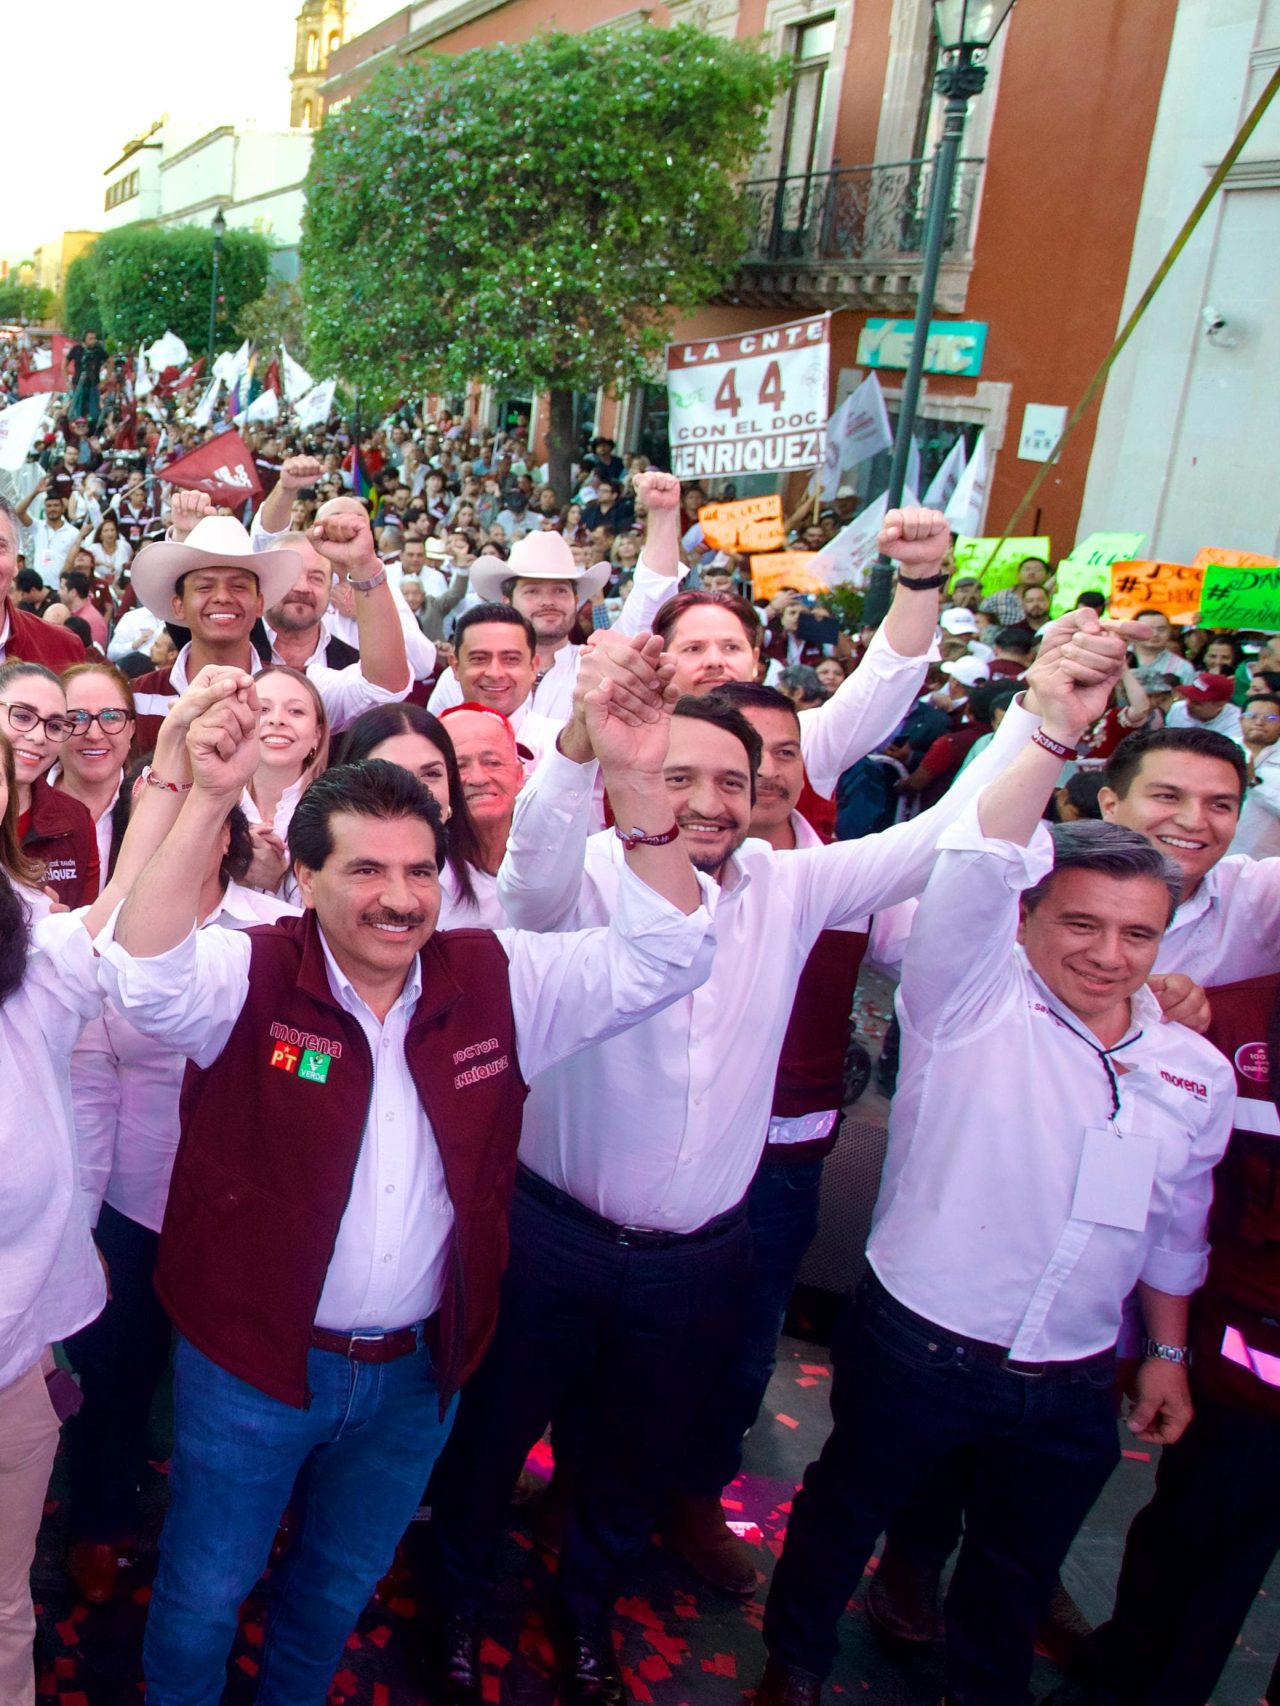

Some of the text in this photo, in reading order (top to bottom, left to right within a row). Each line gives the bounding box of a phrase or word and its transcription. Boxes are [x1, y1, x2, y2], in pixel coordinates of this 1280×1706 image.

[683, 321, 824, 363] LA CNTE
[678, 424, 726, 440] CON
[735, 420, 763, 435] EL
[270, 1021, 342, 1059] morena
[271, 1050, 297, 1071] PT
[454, 1055, 509, 1089] ENRÍQUEZ
[300, 1068, 326, 1084] VERDE
[1160, 1070, 1207, 1097] morena
